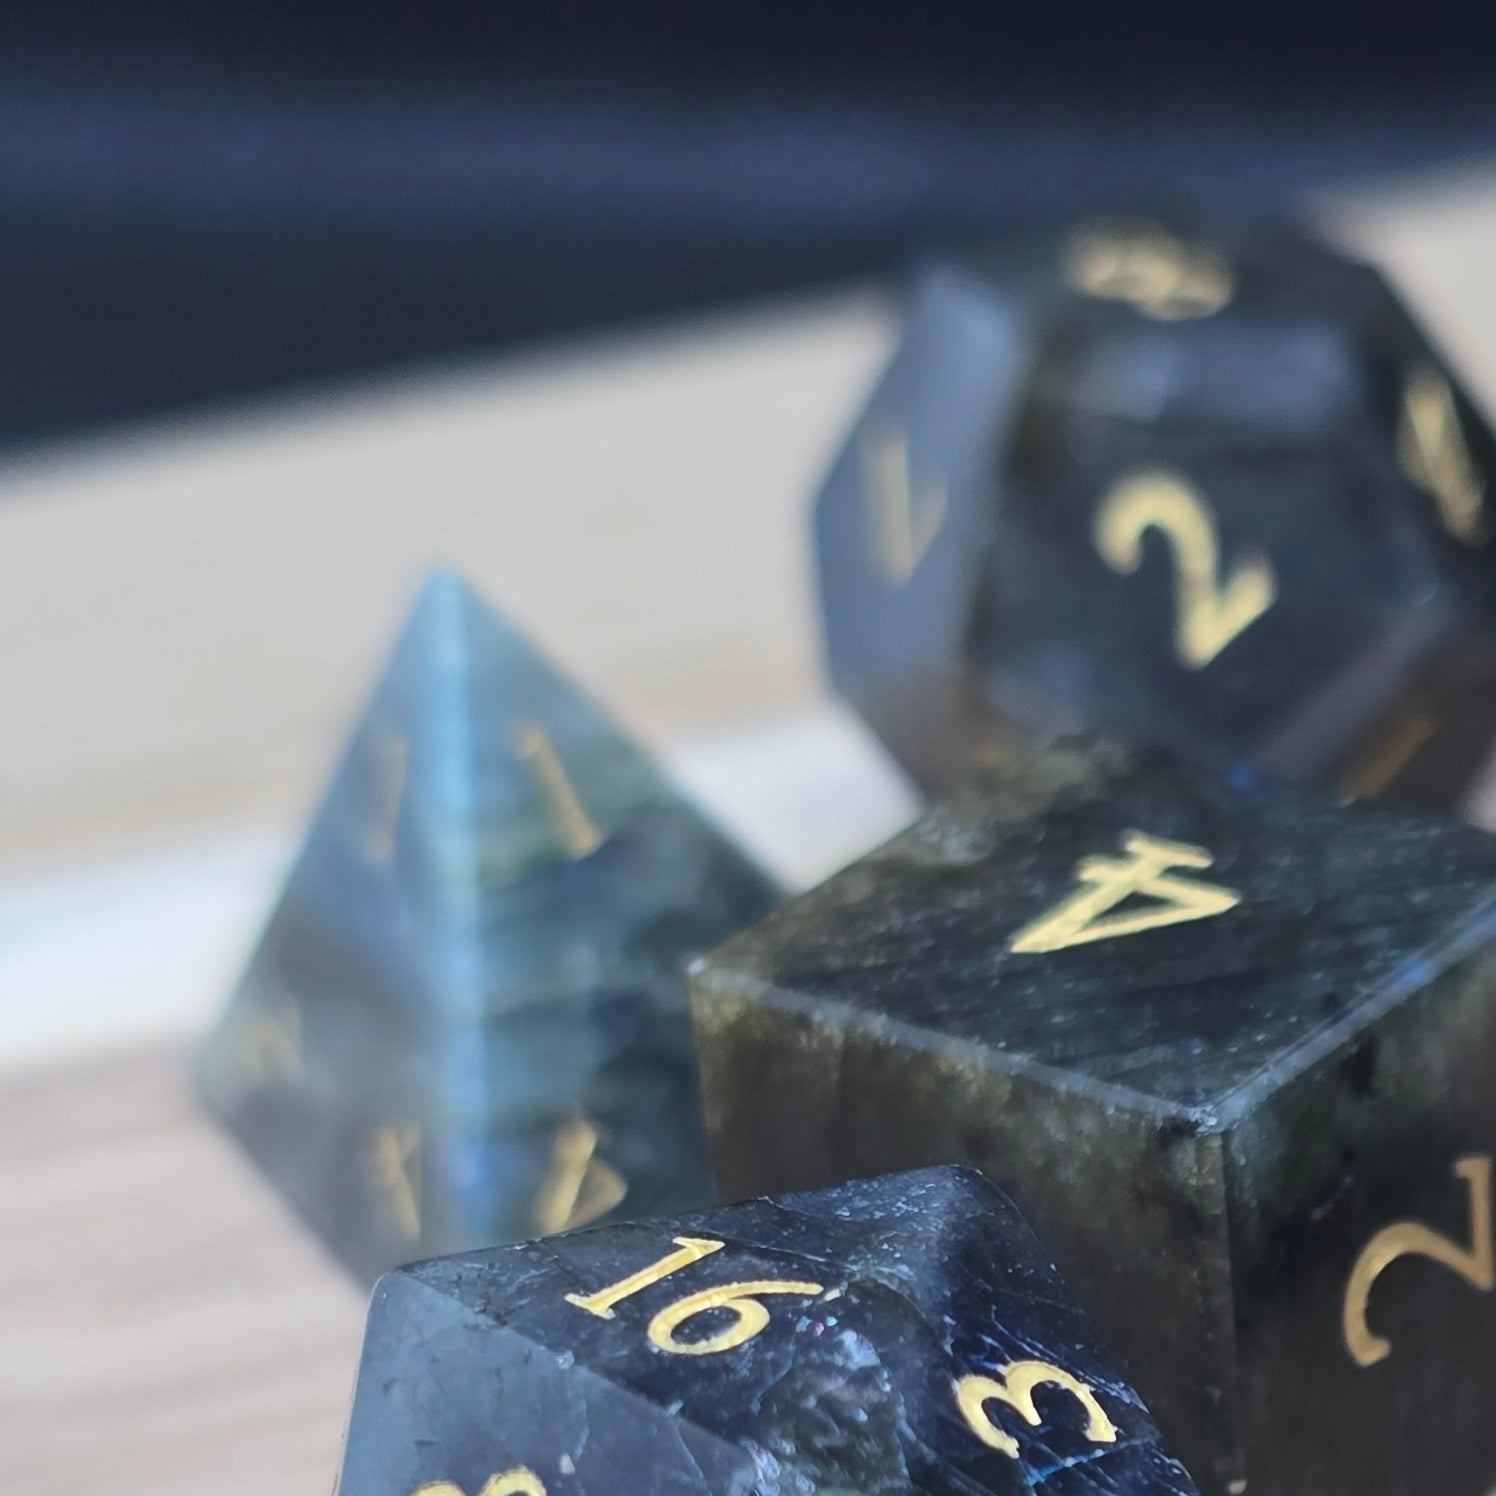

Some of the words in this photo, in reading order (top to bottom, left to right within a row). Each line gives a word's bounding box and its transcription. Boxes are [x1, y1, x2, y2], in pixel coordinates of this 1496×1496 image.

[1092, 466, 1278, 670] 2
[1010, 828, 1241, 955] 4
[564, 1235, 824, 1357] 16
[1342, 1154, 1494, 1369] 2
[952, 1360, 1117, 1459] 3
